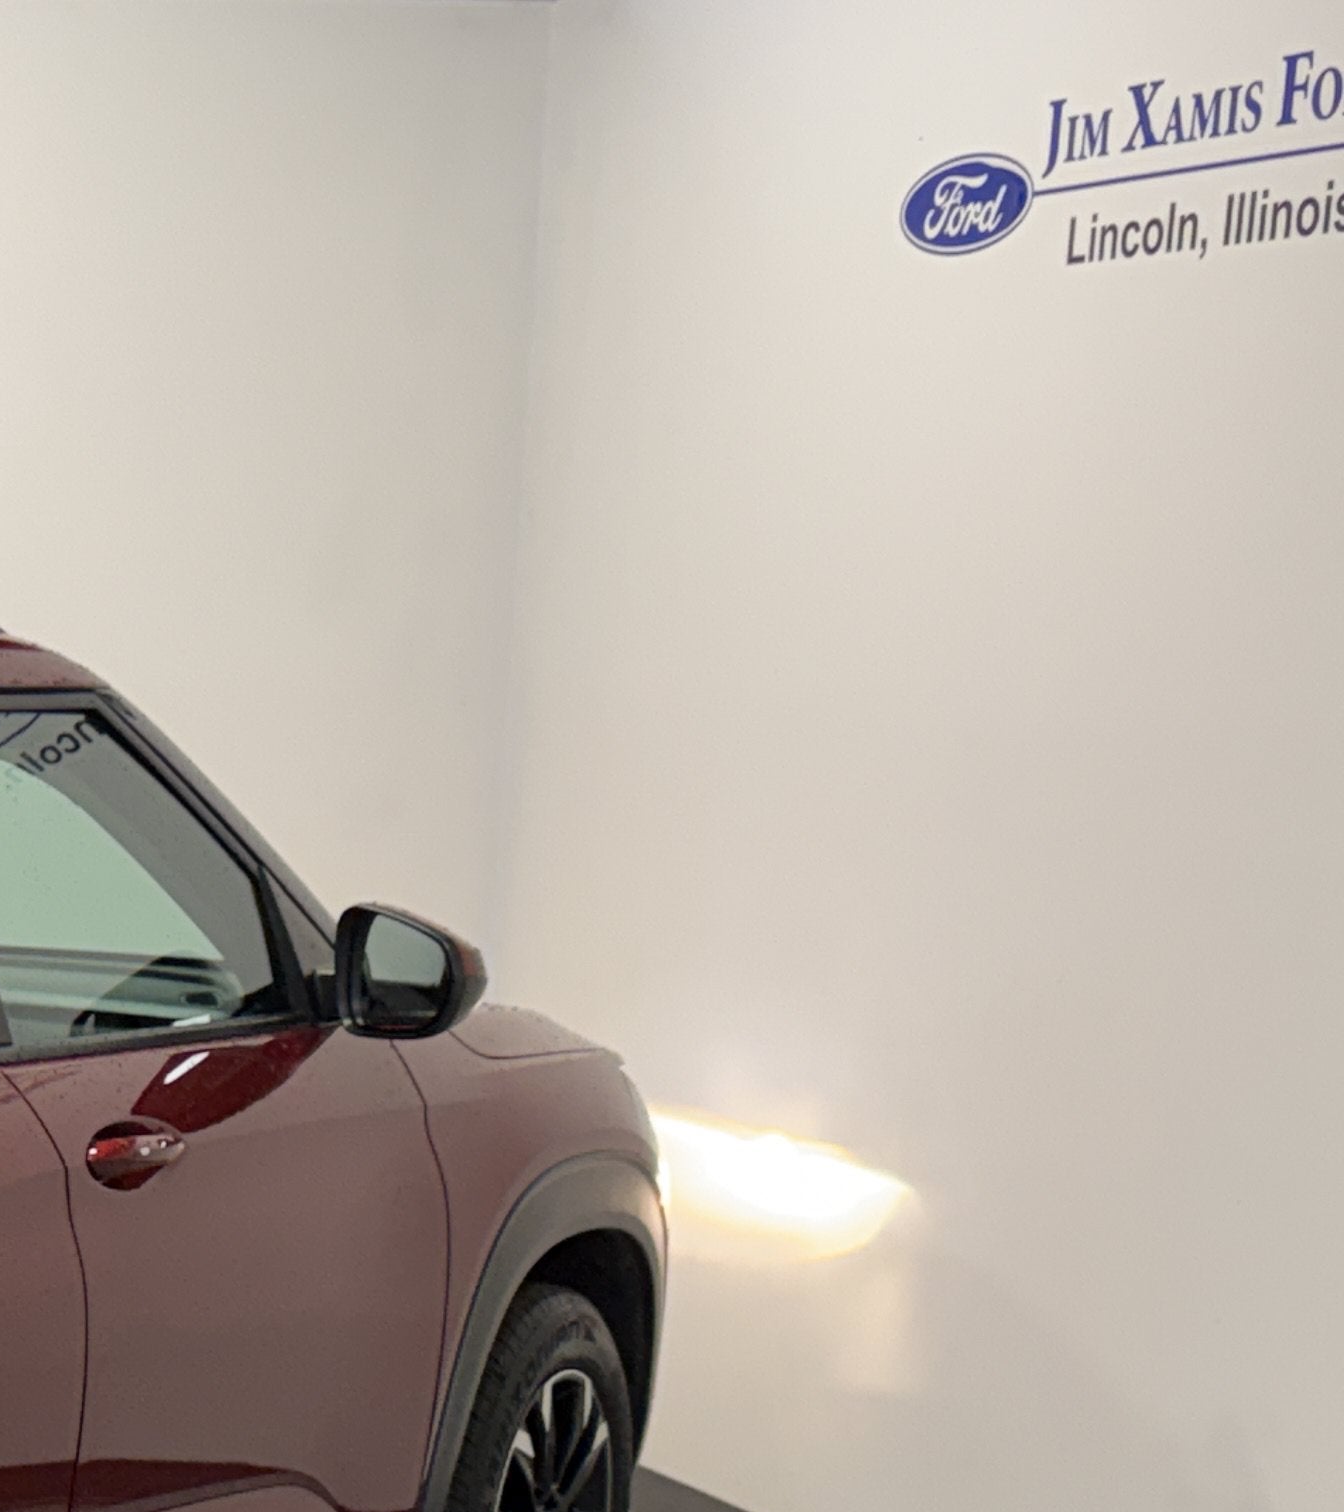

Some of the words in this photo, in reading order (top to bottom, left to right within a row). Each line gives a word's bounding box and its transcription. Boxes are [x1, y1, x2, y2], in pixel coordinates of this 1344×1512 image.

[1041, 97, 1113, 179] JIM
[1120, 78, 1264, 154] XAMIS
[1275, 49, 1344, 127] FO
[1065, 201, 1209, 266] Lincoln,
